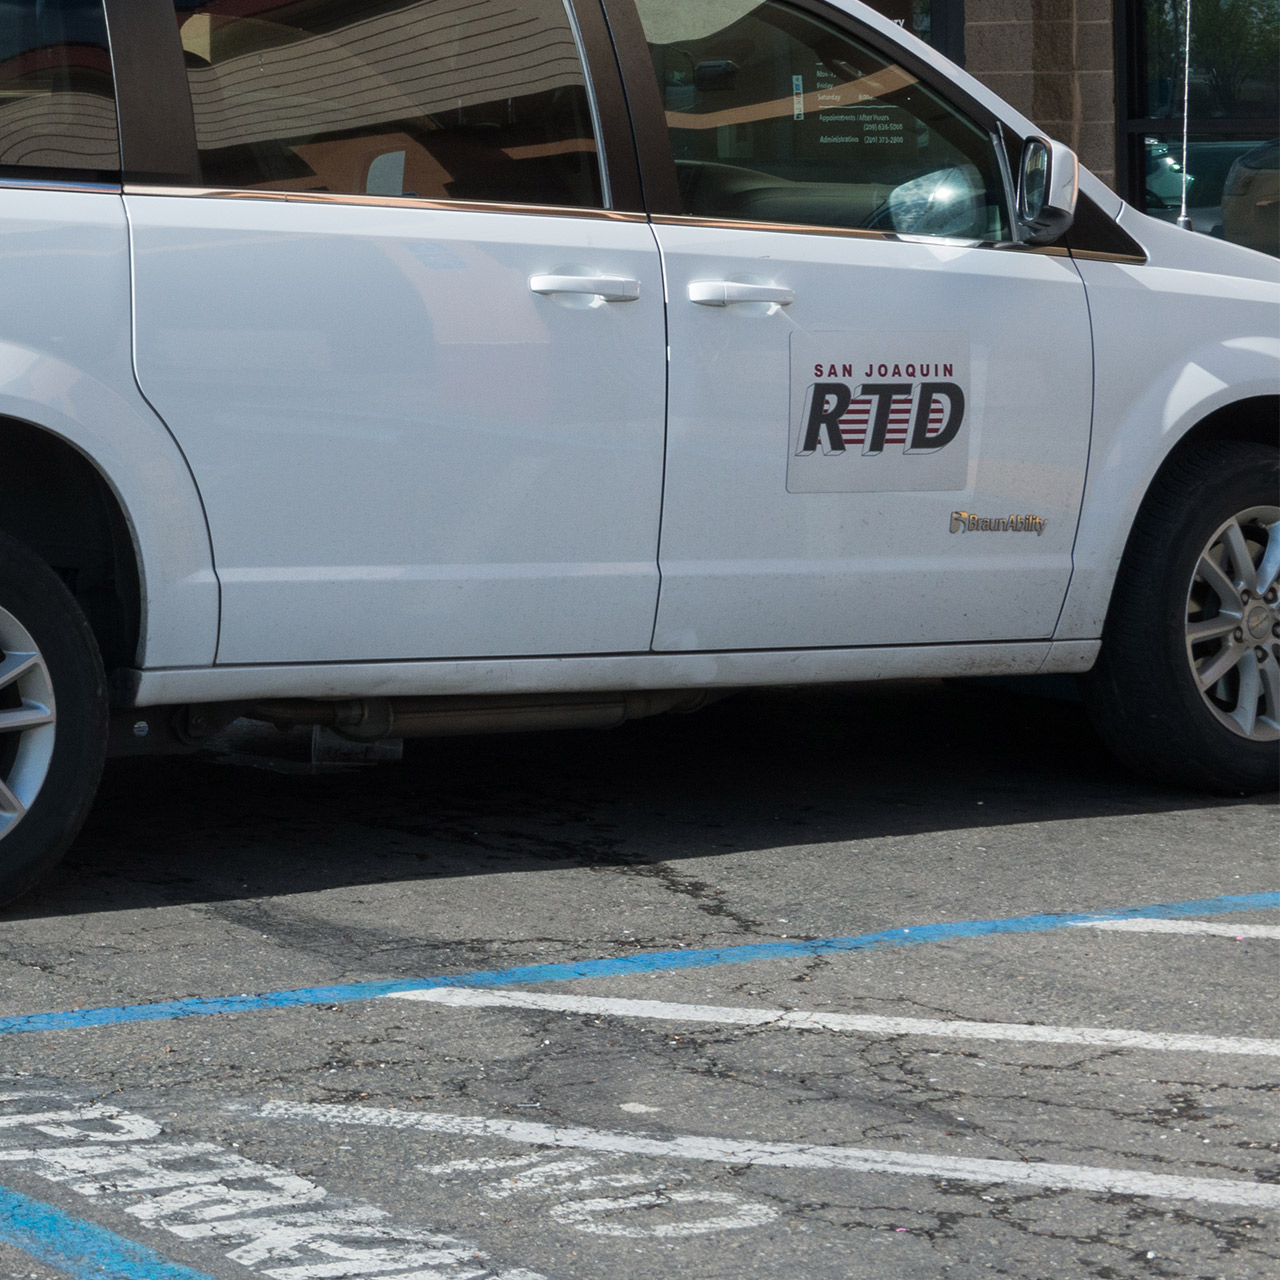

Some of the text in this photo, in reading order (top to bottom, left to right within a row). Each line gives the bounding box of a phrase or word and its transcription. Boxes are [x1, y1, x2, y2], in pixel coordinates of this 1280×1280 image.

[817, 93, 841, 102] Saturday
[819, 114, 856, 122] Appointments
[863, 123, 877, 131] (209)
[814, 363, 954, 378] SAN JOAQUIN
[795, 382, 965, 457] RTD
[967, 513, 1048, 536] BraunAbility
